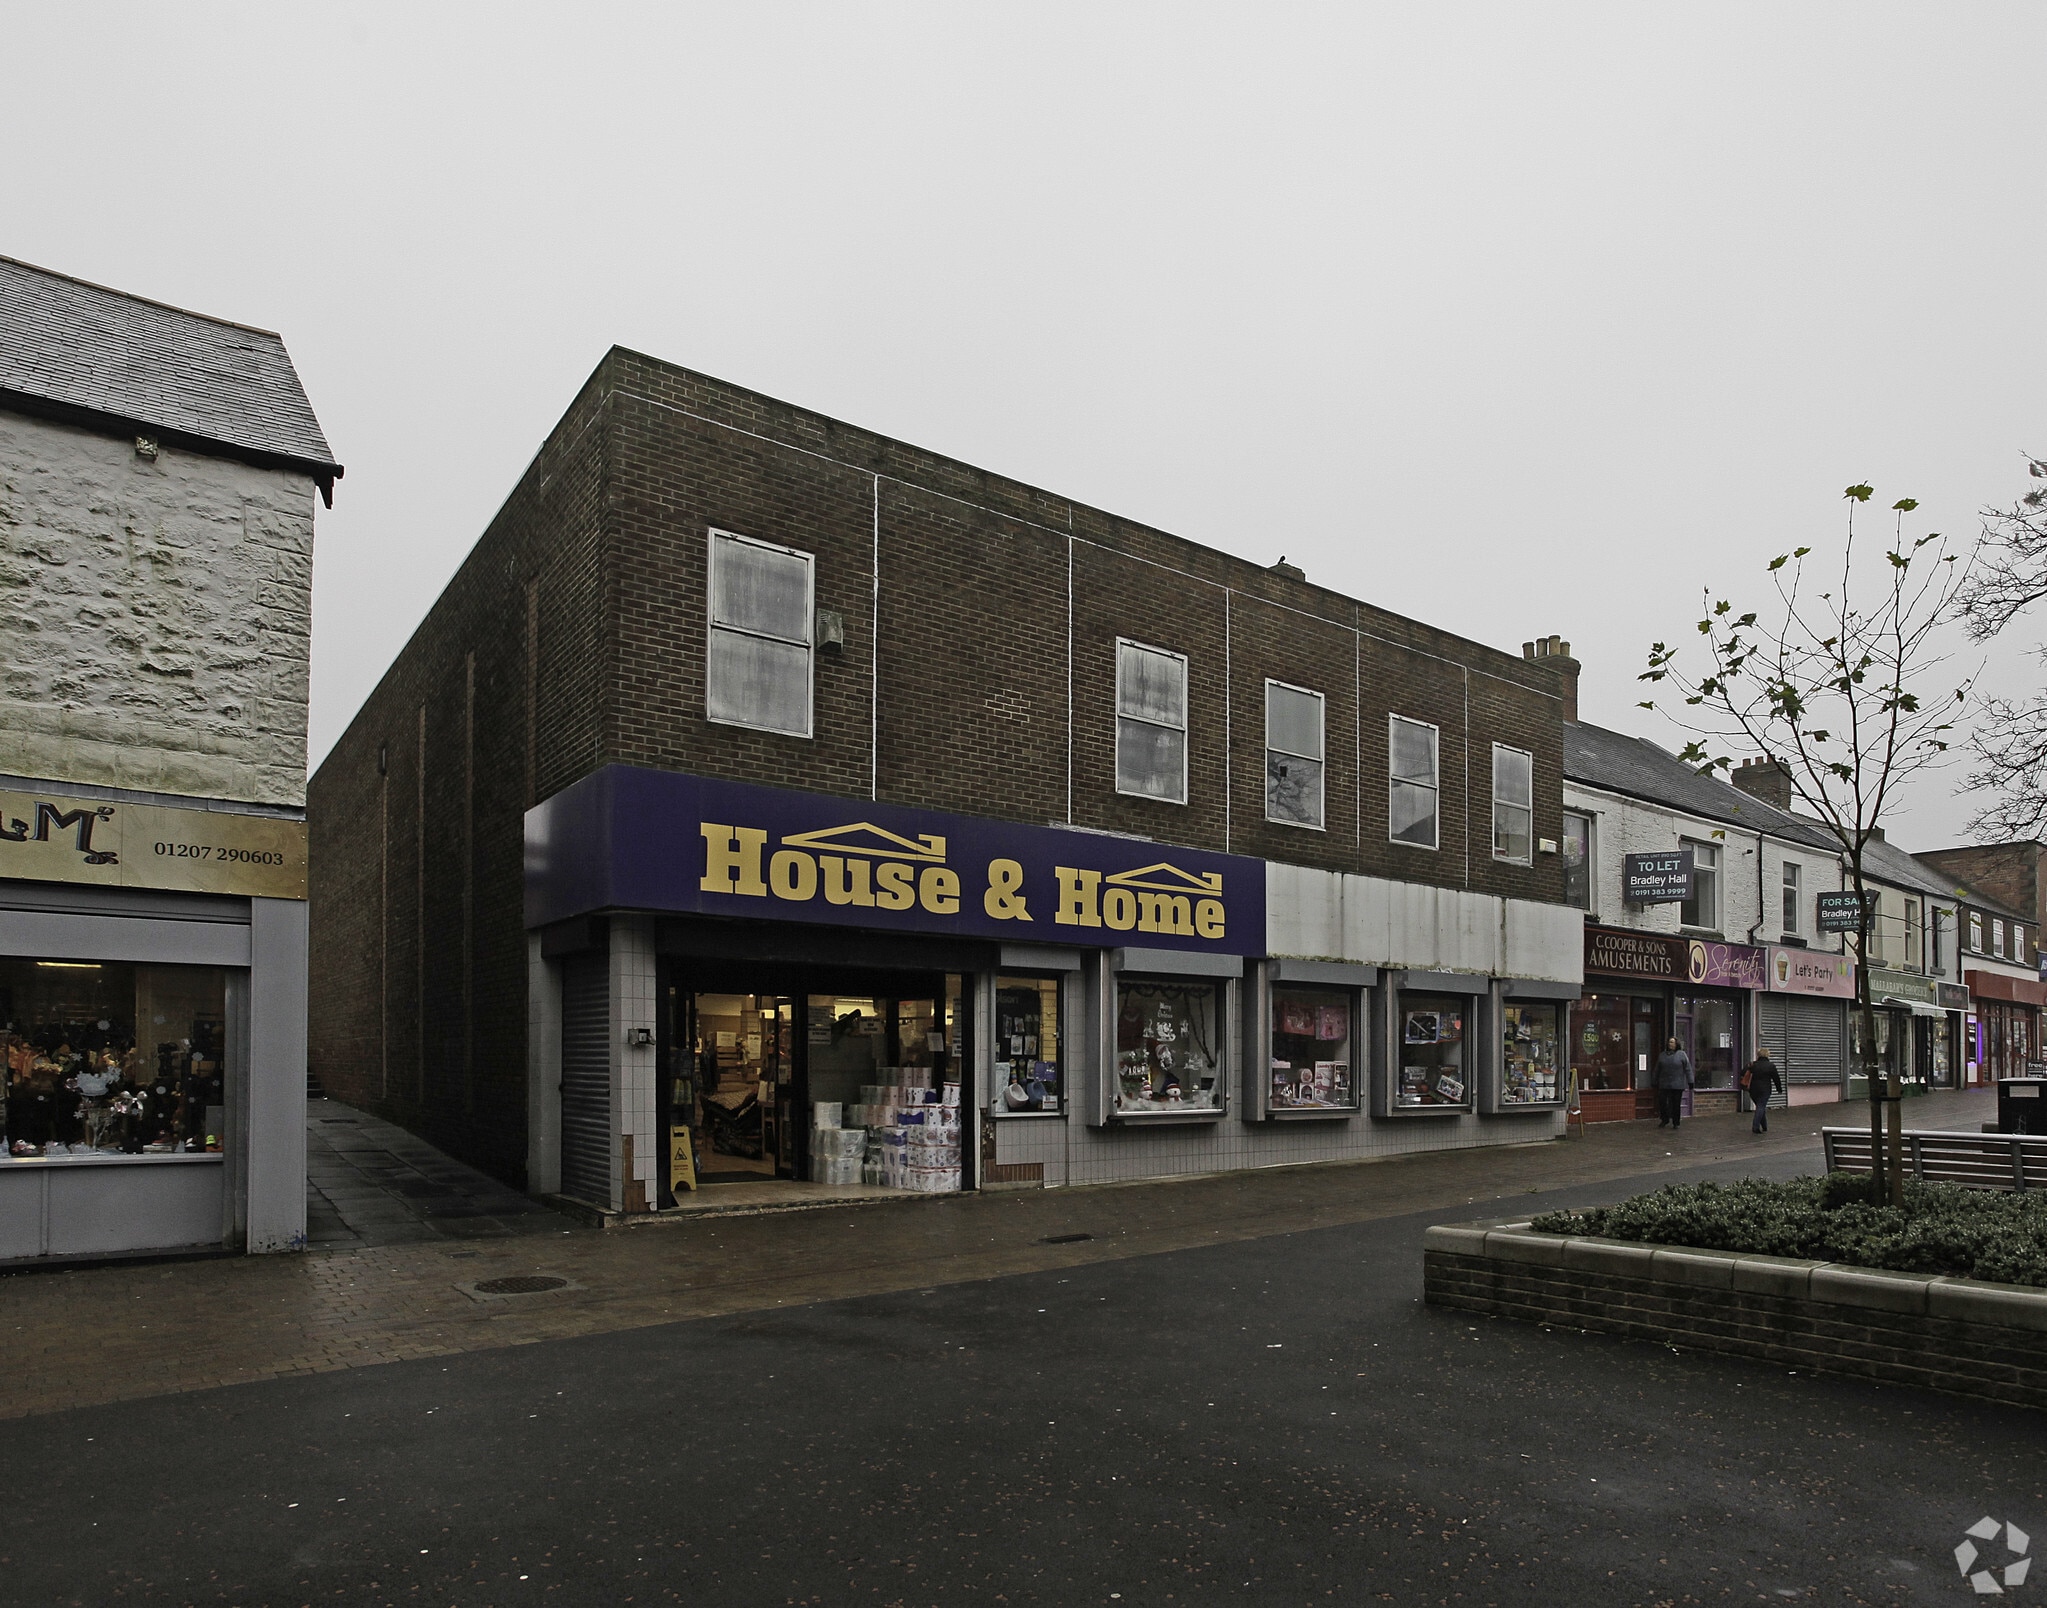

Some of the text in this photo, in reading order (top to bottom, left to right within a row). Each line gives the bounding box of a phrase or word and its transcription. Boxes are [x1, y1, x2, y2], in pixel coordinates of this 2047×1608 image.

[154, 842, 284, 866] 01207 290603
[1637, 860, 1681, 872] TO LET
[700, 822, 1225, 939] House & Home
[1630, 873, 1687, 887] Bradley Hall
[1651, 888, 1666, 896] 383
[1667, 887, 1687, 895] 9999
[1822, 897, 1871, 907] FOR SAE
[1821, 909, 1852, 920] Bradley
[1638, 940, 1645, 953] &
[1645, 941, 1667, 956] SONS
[1589, 949, 1672, 974] AMUSEMENTS
[1707, 944, 1765, 988] Serenity
[1795, 963, 1833, 982] Let's Party
